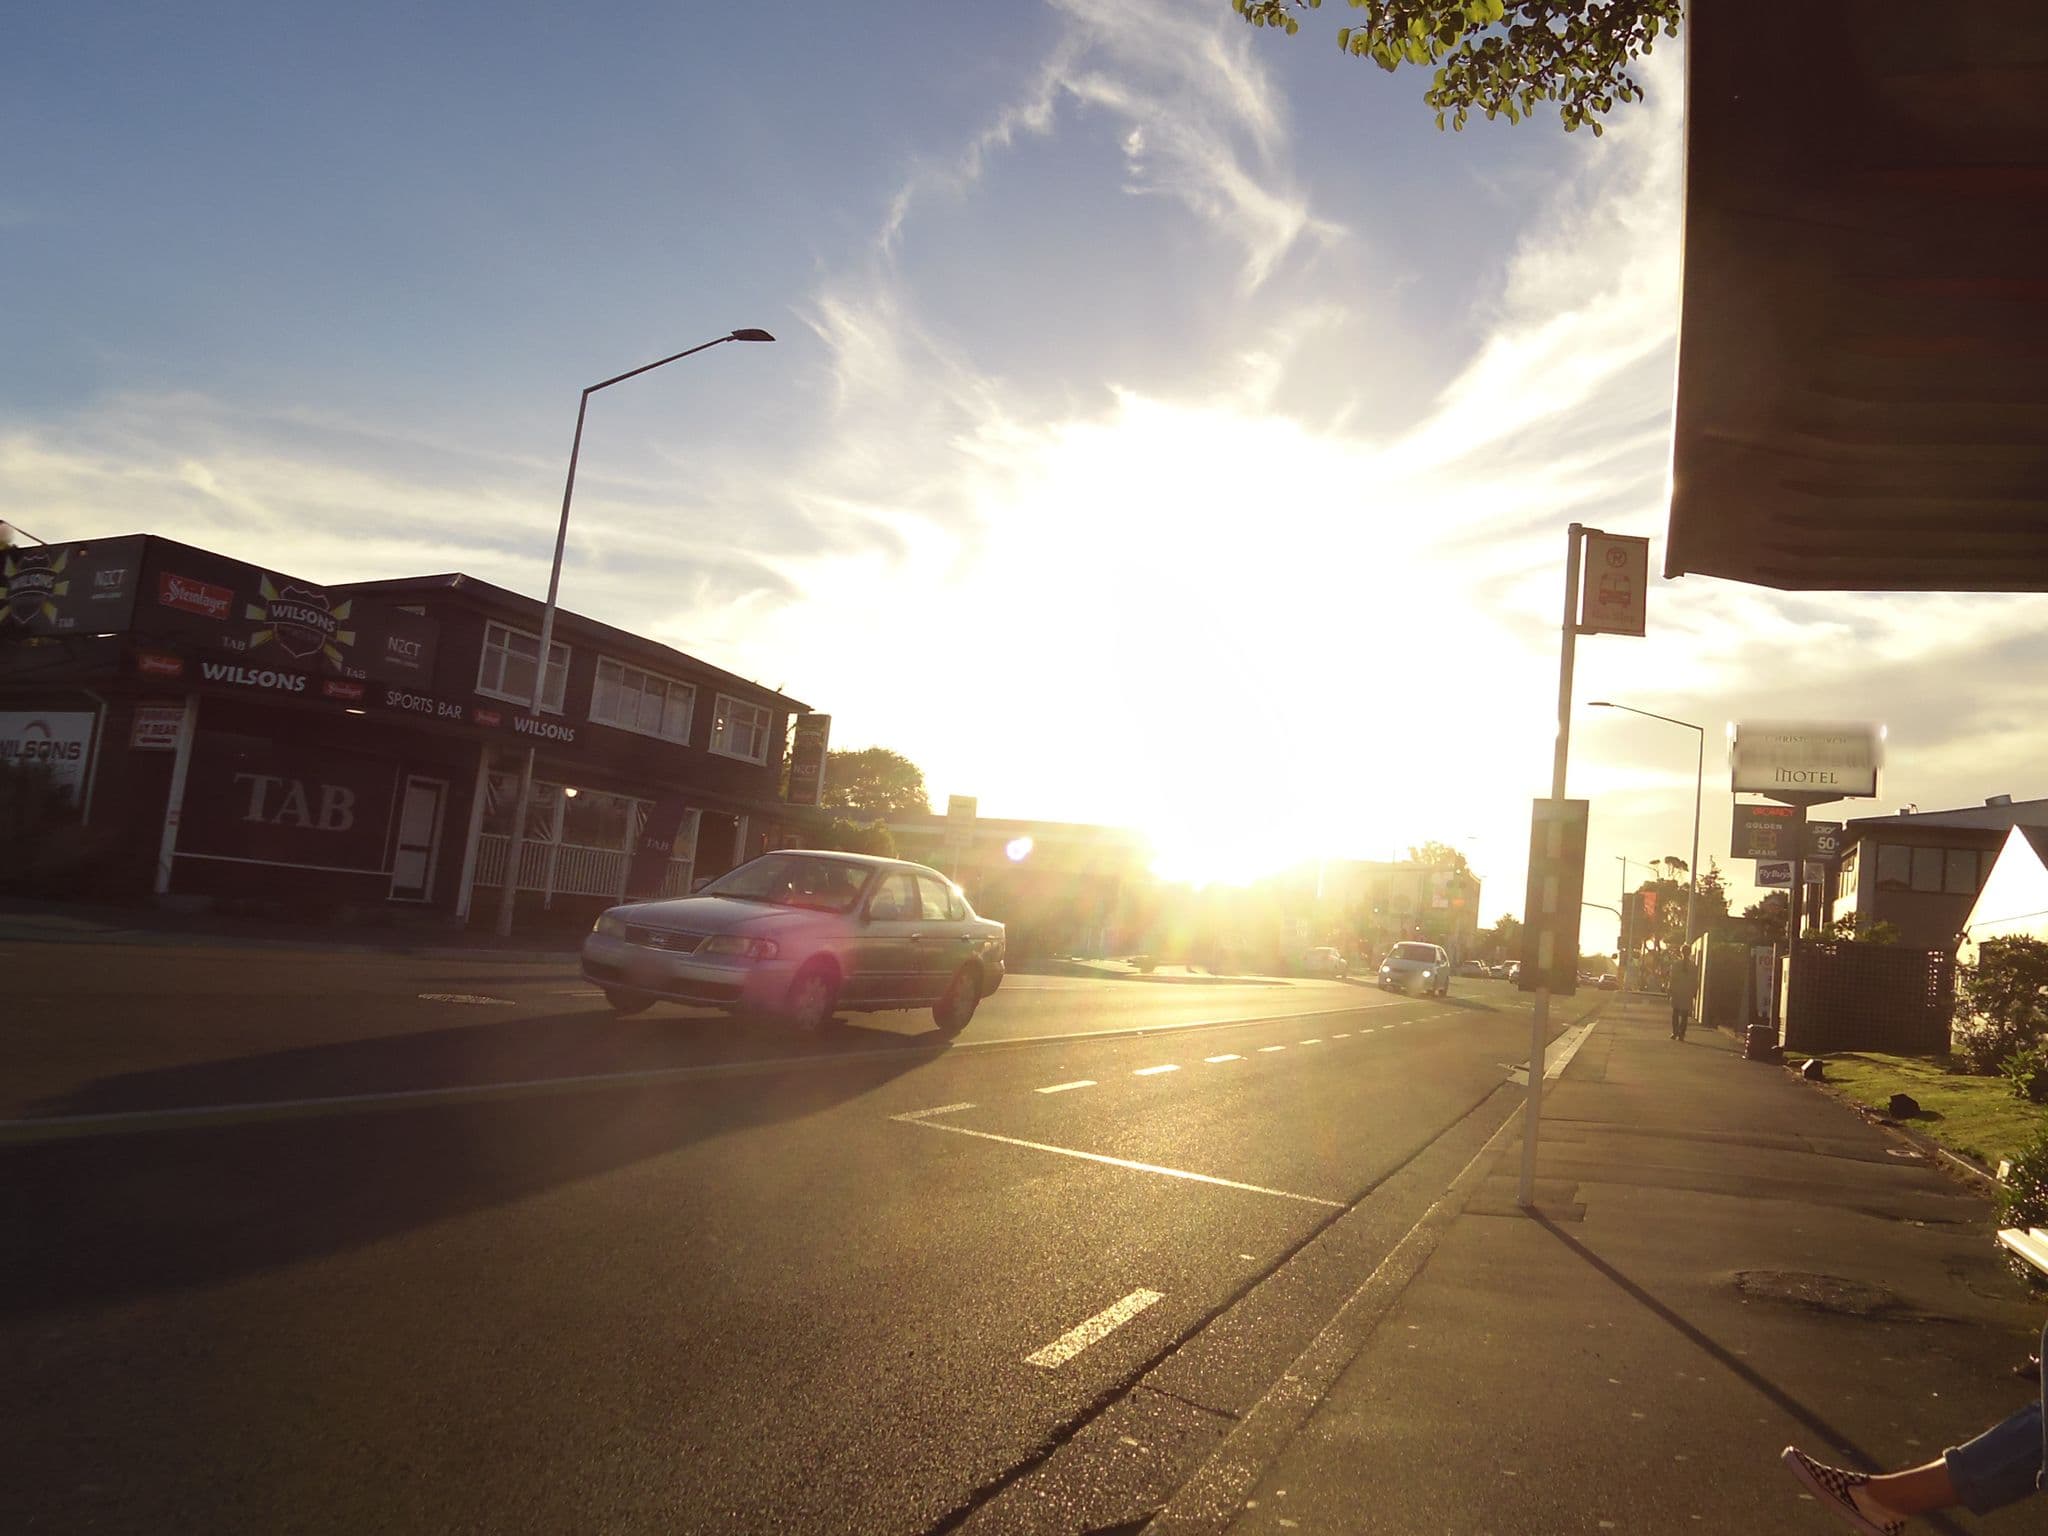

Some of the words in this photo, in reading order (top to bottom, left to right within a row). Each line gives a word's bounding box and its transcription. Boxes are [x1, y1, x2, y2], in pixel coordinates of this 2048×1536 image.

[160, 578, 229, 614] Steinlager
[271, 604, 337, 633] WILSONS
[222, 636, 247, 651] TAB
[202, 661, 307, 692] WILSONS
[386, 691, 433, 713] SPORTS
[437, 702, 462, 719] BAR
[514, 716, 576, 742] WILSONS
[1775, 768, 1838, 784] MOTEL
[233, 772, 355, 832] TAB
[1745, 822, 1783, 831] GOLDEN
[1748, 848, 1778, 857] CHAIN
